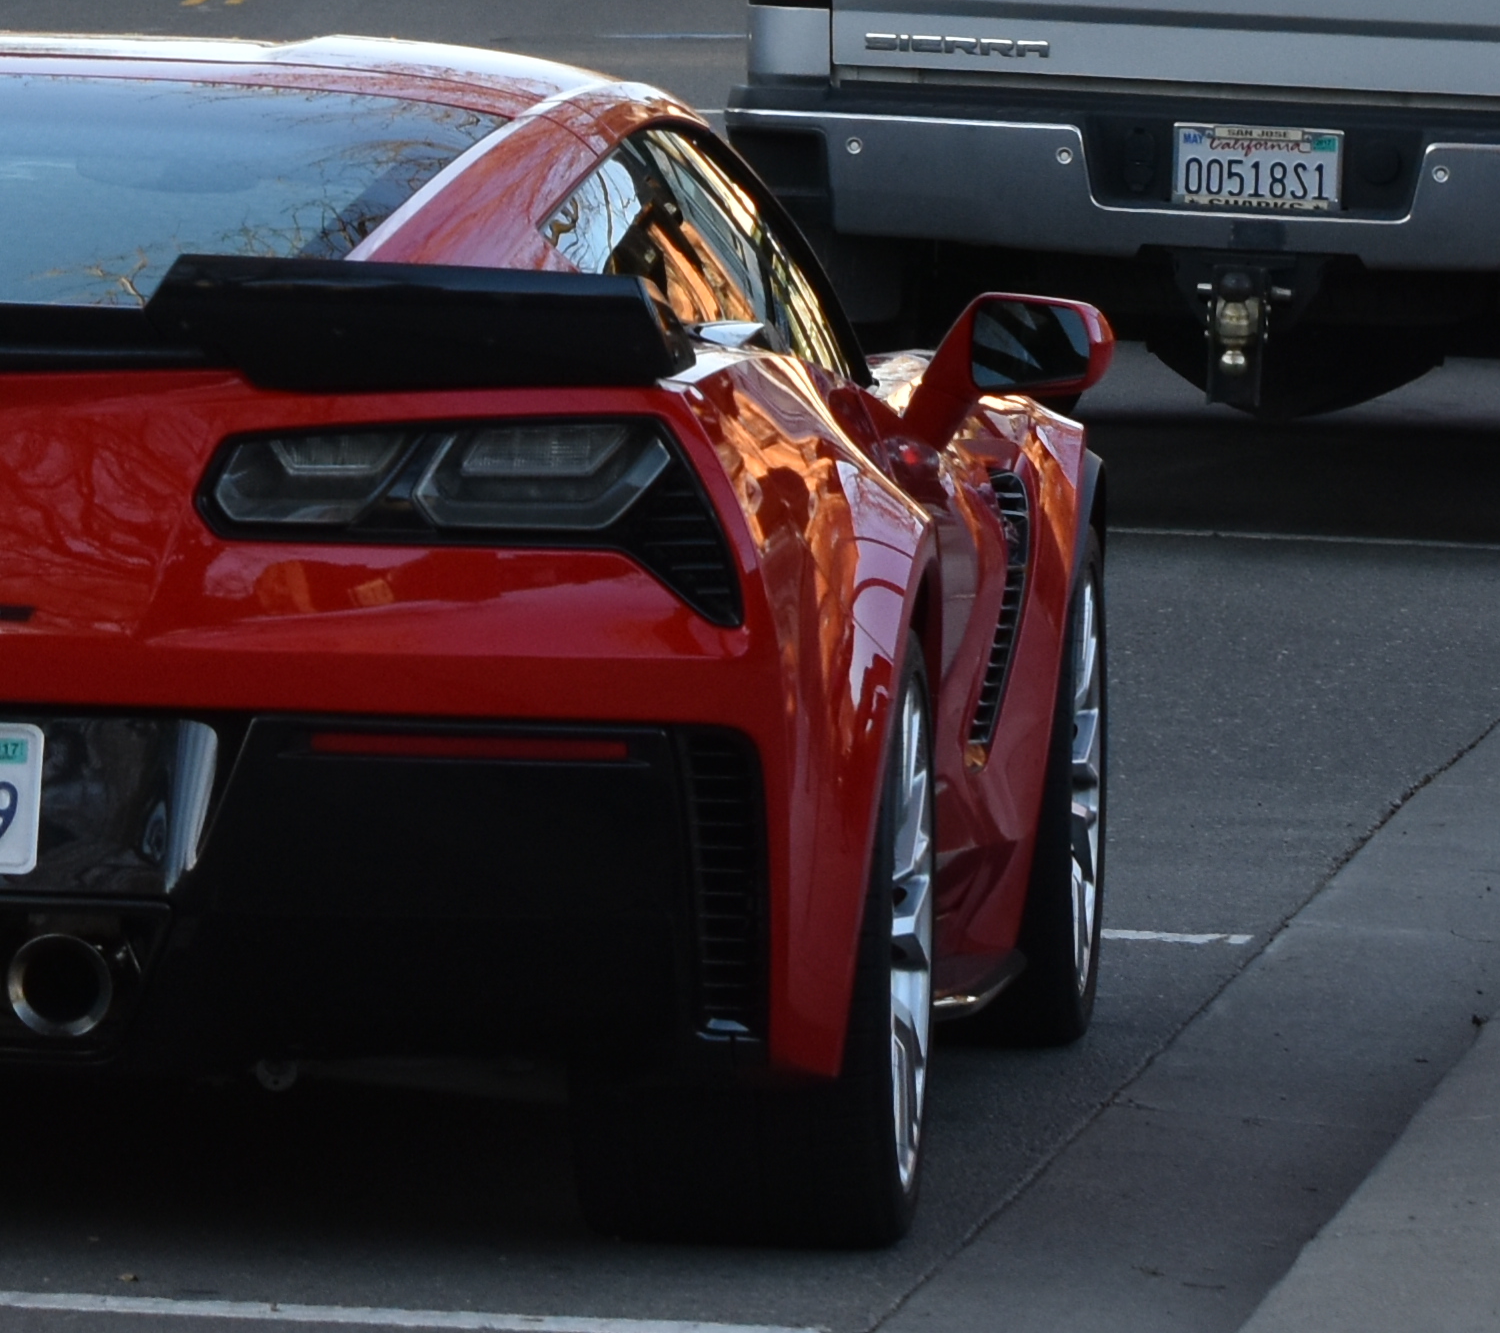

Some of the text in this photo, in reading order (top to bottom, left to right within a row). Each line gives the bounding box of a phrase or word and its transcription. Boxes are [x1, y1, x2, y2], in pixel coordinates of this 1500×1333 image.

[864, 32, 1051, 59] SIERRA
[1182, 132, 1205, 145] MAY
[1208, 136, 1313, 158] California
[1227, 128, 1290, 139] SAN JOSE
[1184, 156, 1330, 201] 00518S1
